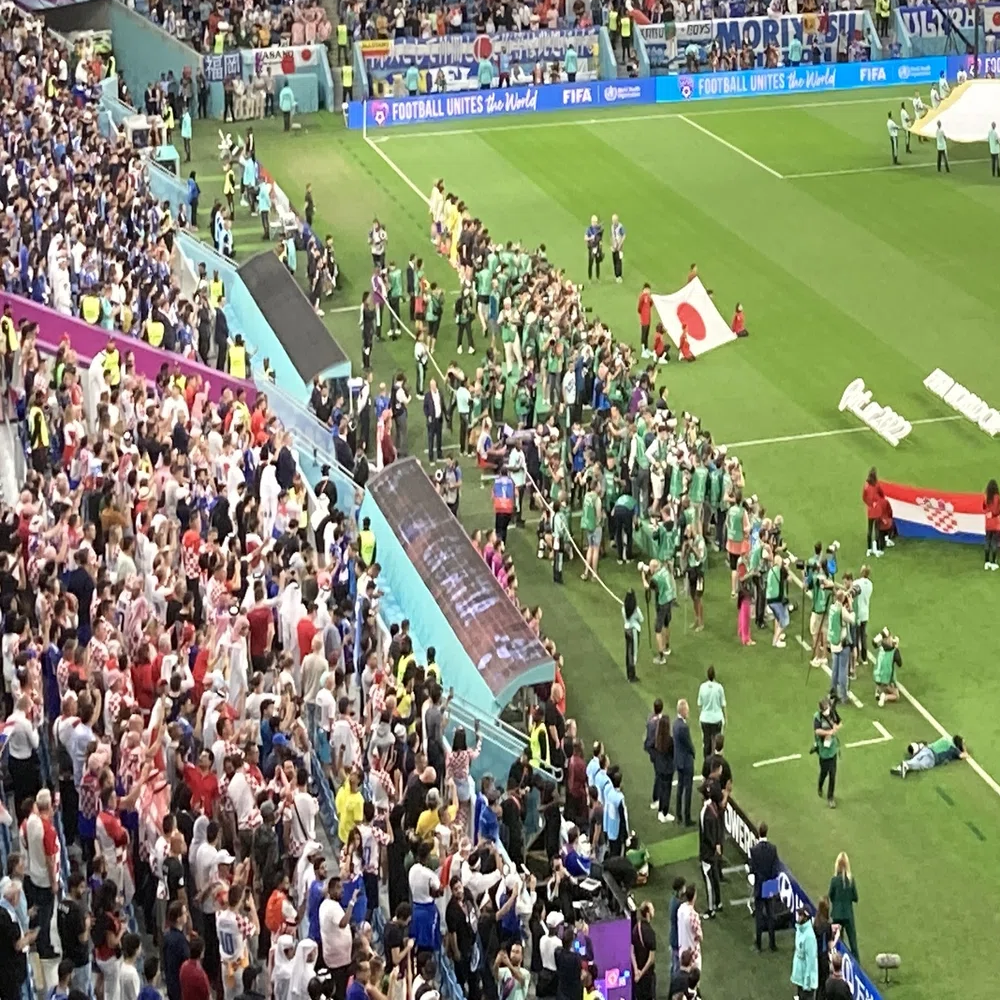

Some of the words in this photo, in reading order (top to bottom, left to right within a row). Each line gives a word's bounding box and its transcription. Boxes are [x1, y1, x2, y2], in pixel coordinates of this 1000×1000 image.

[716, 13, 857, 52] MORIYSU
[699, 76, 747, 95] FOOTBALL
[750, 73, 785, 91] UNITES
[787, 70, 804, 89] the
[805, 67, 836, 88] World
[860, 67, 887, 81] FIFA
[392, 101, 444, 120] FOOTBALL
[446, 95, 484, 115] UNITES
[484, 92, 504, 113] the
[504, 88, 538, 111] World
[563, 88, 592, 104] FIFA
